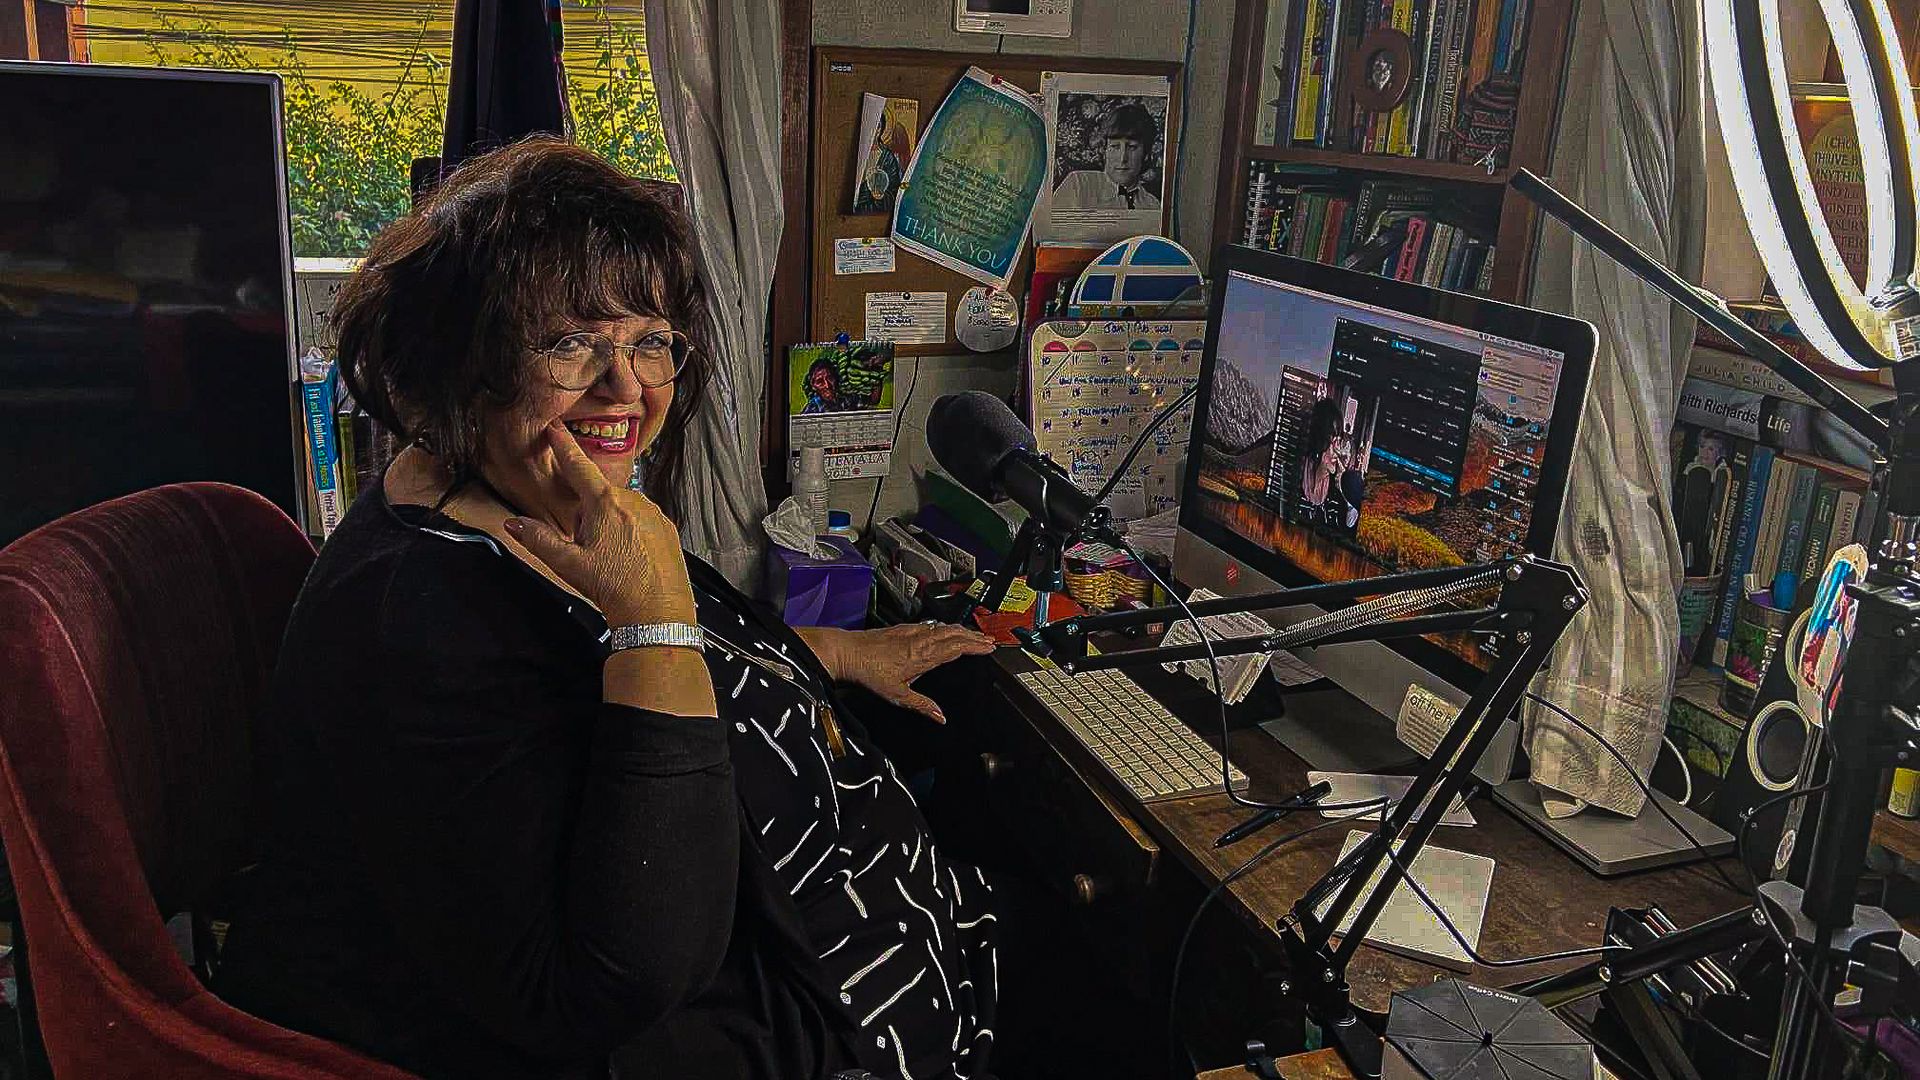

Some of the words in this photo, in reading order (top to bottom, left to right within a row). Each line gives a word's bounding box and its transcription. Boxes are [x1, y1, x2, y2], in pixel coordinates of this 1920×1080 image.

[905, 215, 962, 255] THANK
[968, 242, 1007, 270] YOU
[1696, 363, 1736, 381] JULIA
[1742, 374, 1786, 394] CHILD
[311, 413, 327, 449] Fabulous
[1680, 393, 1701, 410] eith
[1703, 398, 1758, 425] Richards
[1766, 414, 1791, 434] Life
[1408, 693, 1429, 710] off
